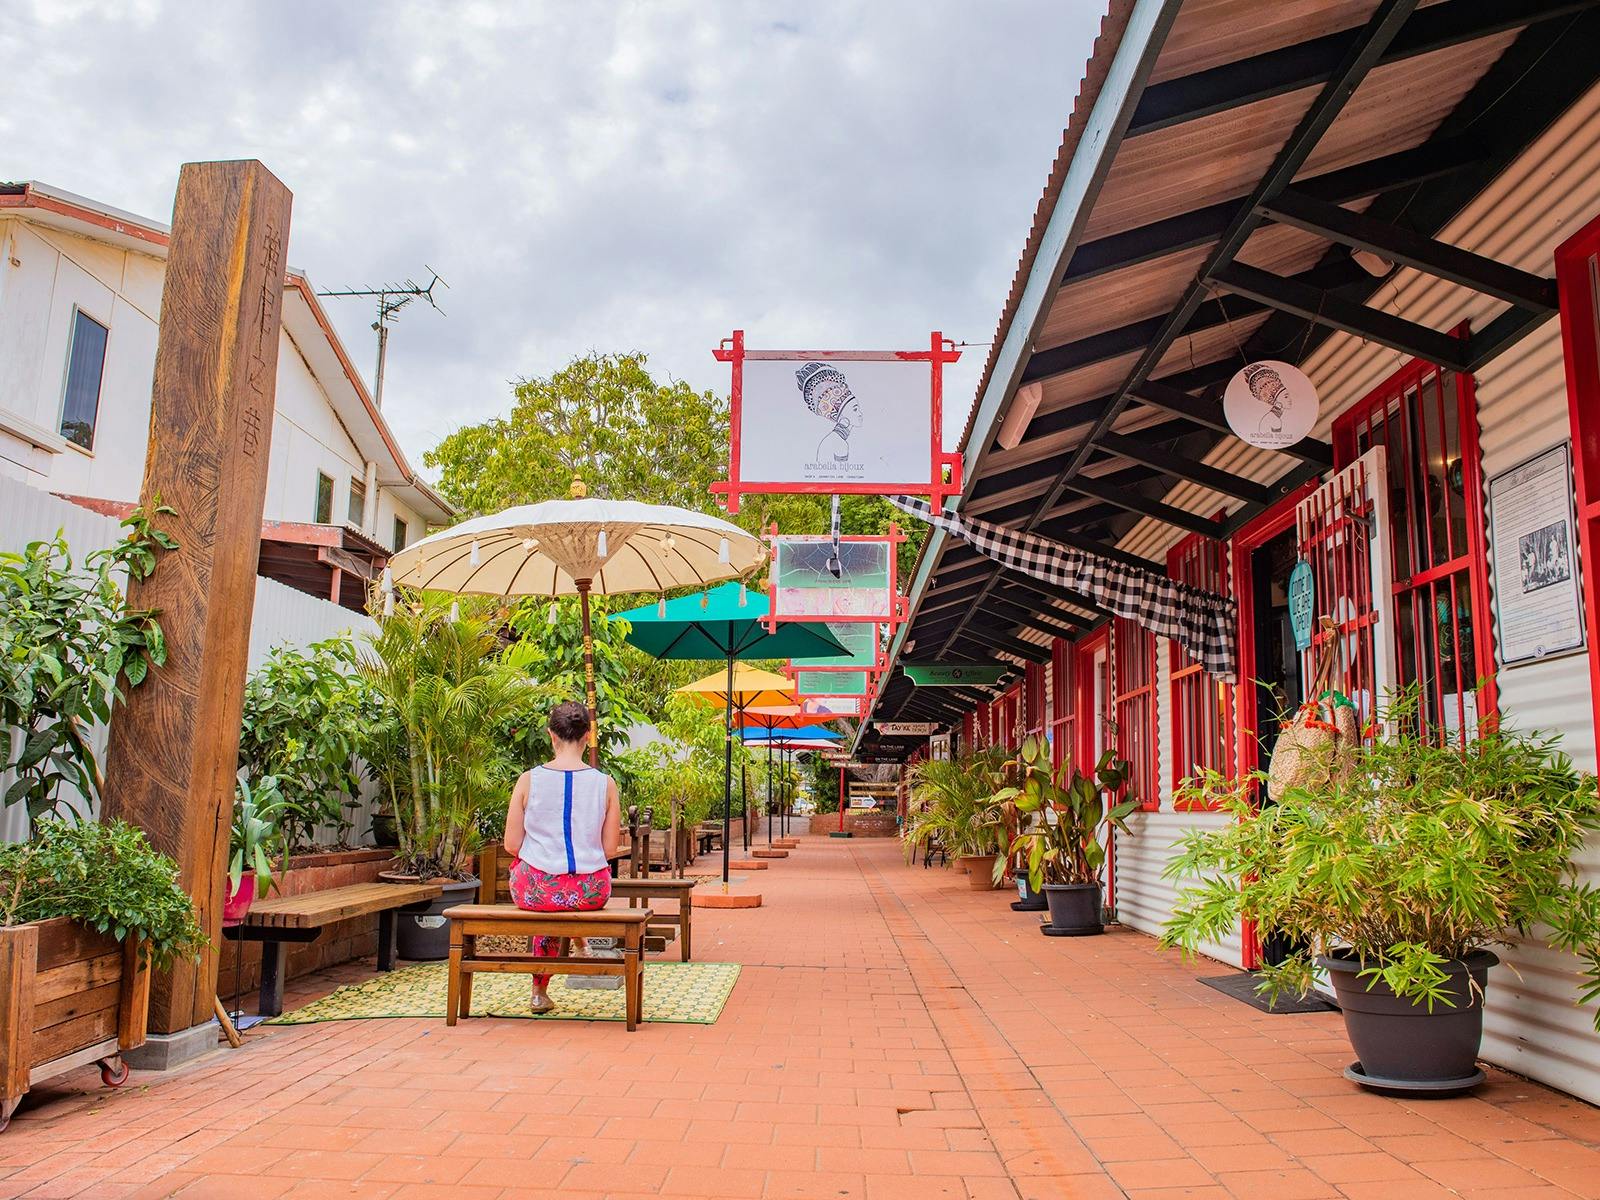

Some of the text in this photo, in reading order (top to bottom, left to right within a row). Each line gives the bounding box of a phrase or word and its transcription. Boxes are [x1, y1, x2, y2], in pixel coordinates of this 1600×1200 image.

[804, 461, 865, 473] arabella bijoux
[1292, 576, 1305, 598] COME
[1292, 591, 1311, 616] WE ARE
